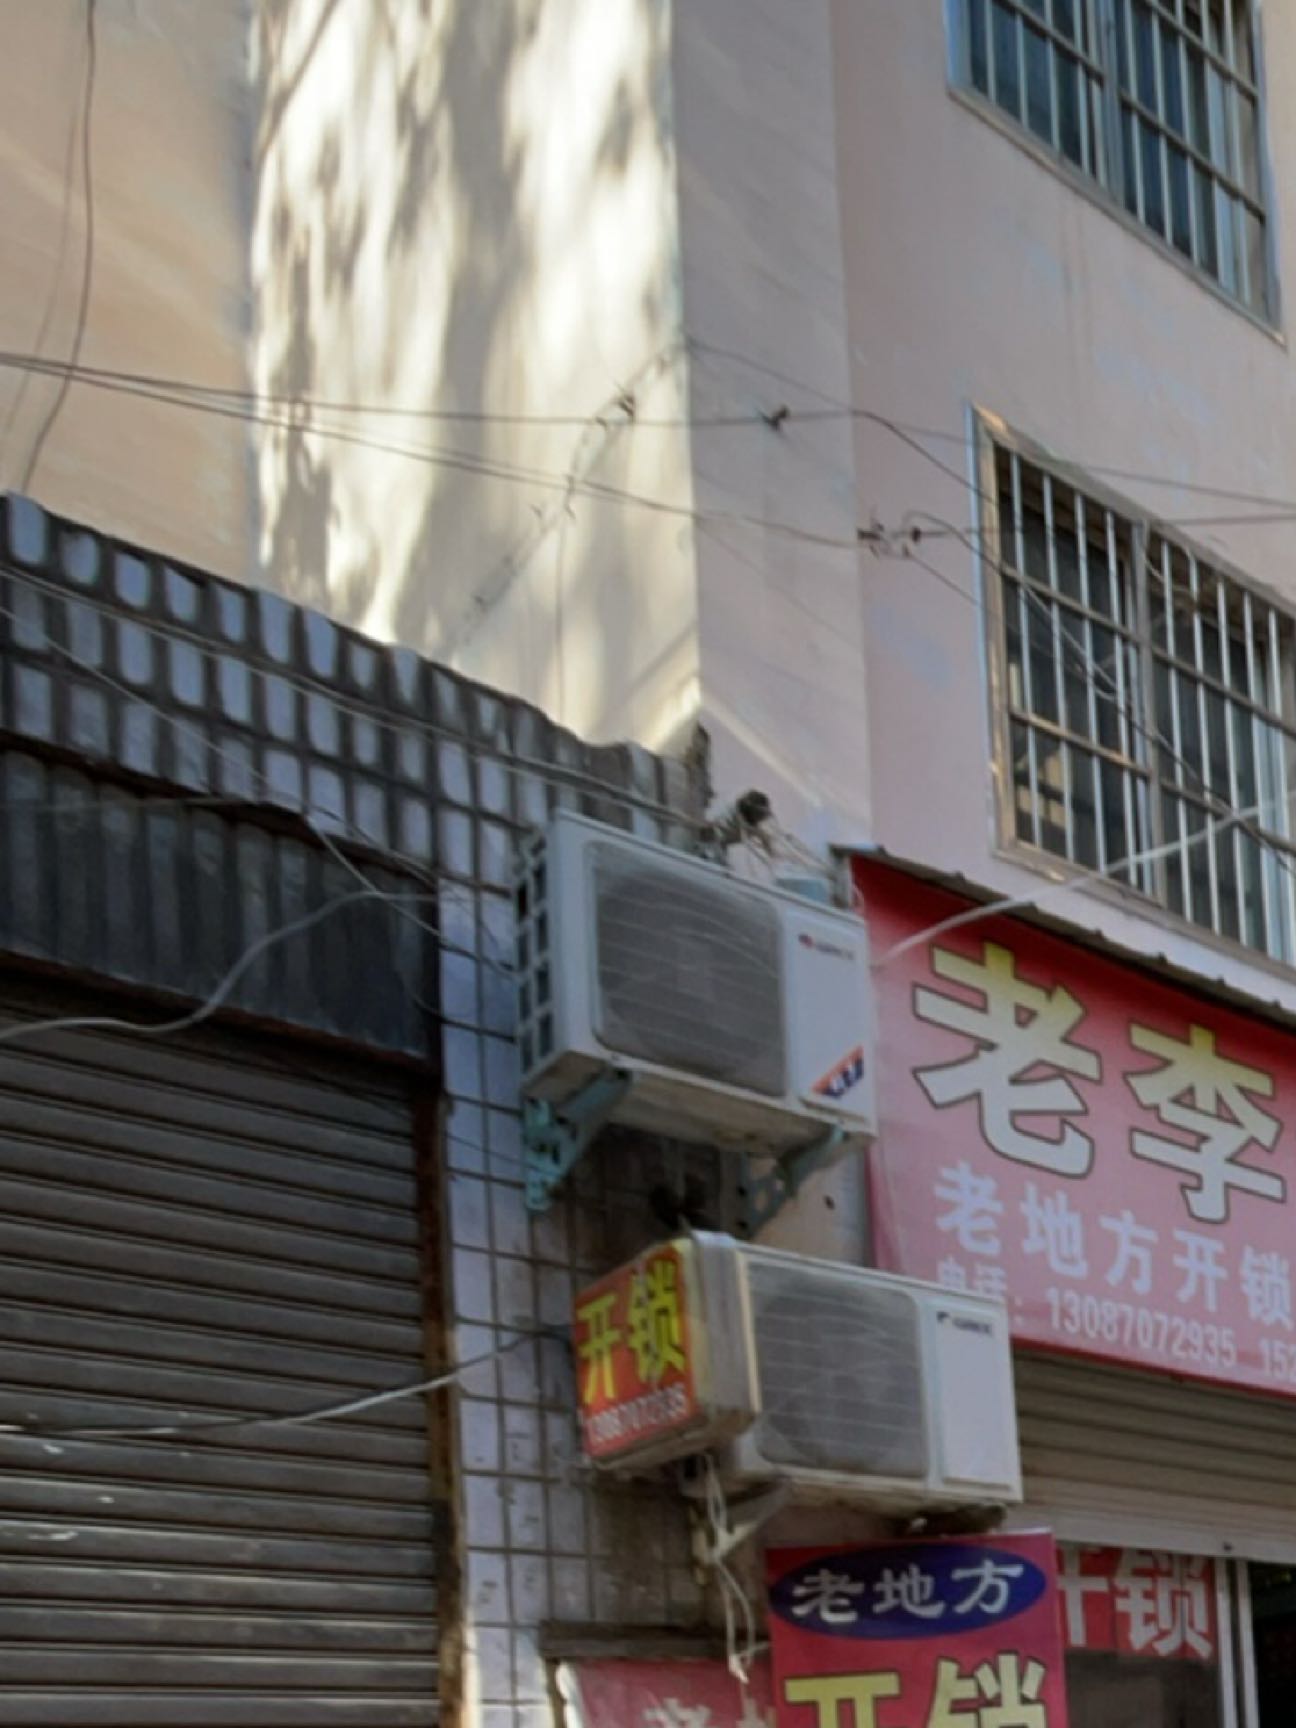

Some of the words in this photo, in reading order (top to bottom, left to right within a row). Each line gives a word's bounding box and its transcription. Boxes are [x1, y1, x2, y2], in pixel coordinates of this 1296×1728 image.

[933, 1161, 1293, 1332] 老地方开锁
[576, 1257, 686, 1405] 开锁
[1046, 1287, 1237, 1368] 13087072935
[790, 1557, 1026, 1624] 老地方
